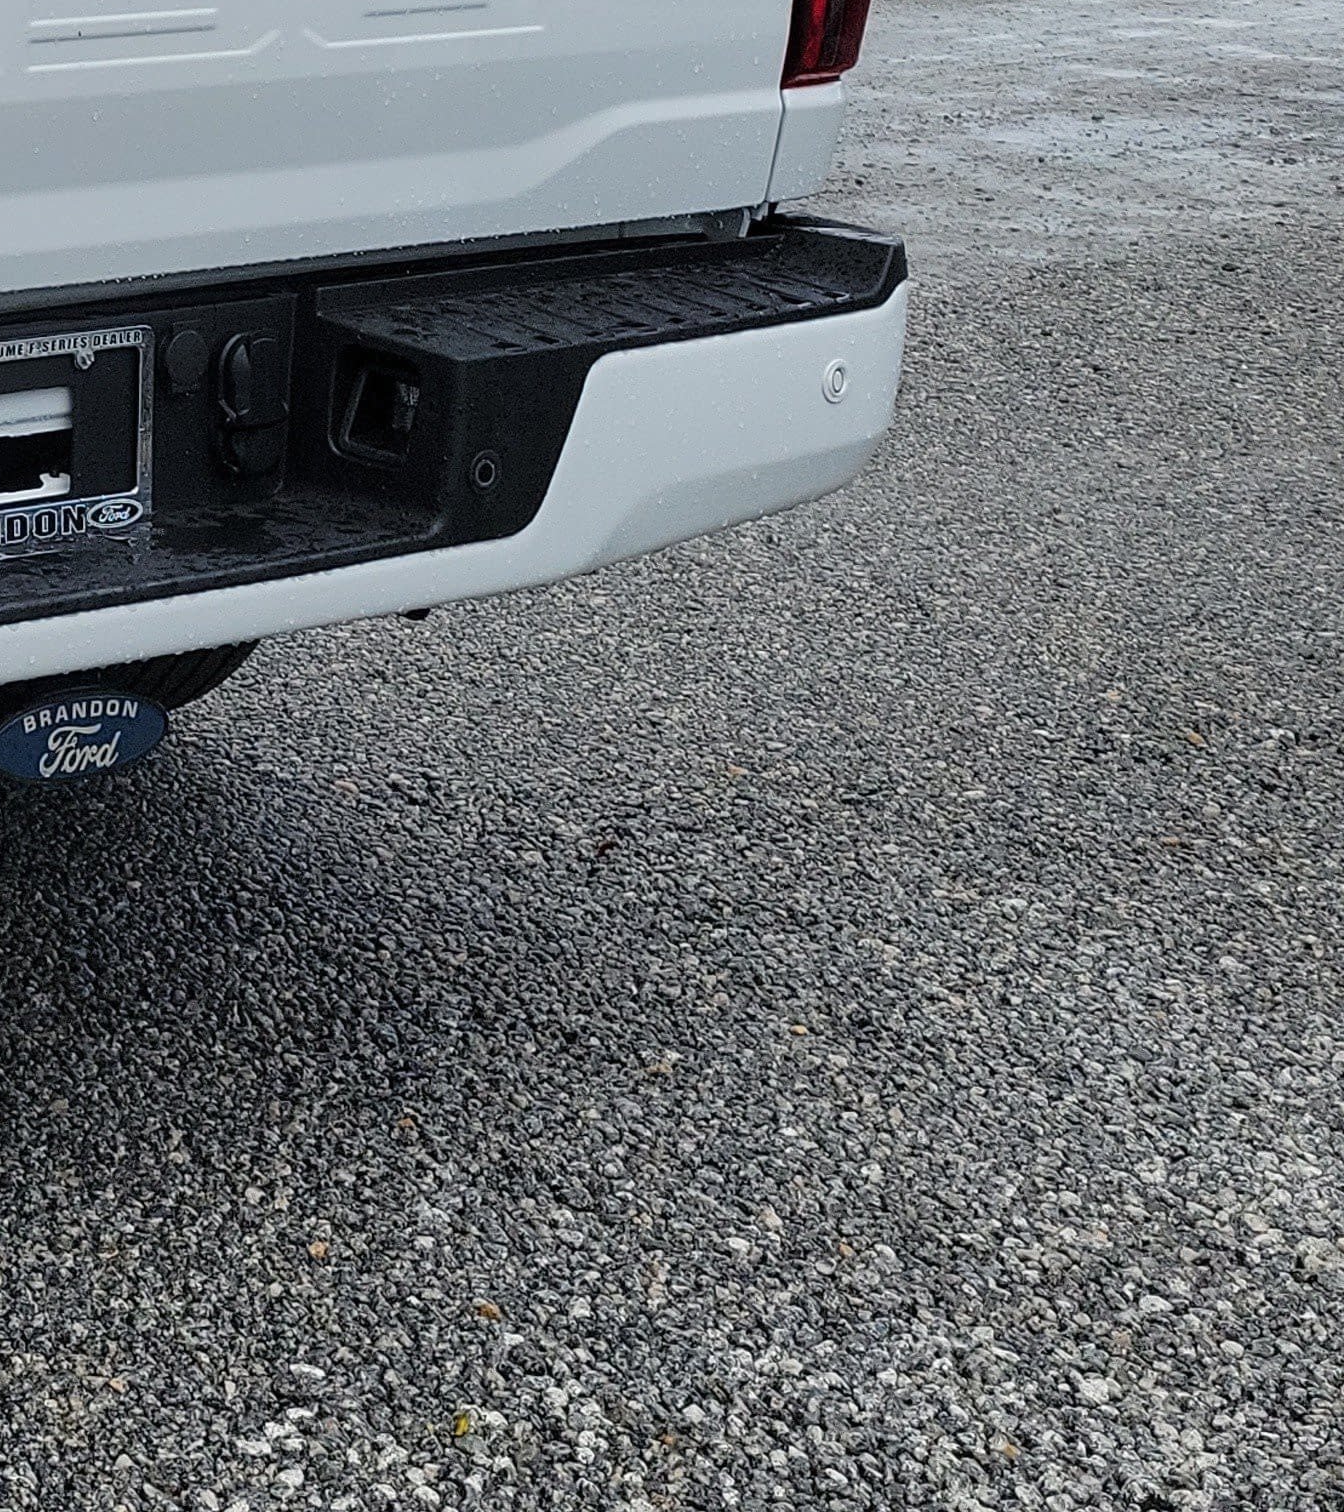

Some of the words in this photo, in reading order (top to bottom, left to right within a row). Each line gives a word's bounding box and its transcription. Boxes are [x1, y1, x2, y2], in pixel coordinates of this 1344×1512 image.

[28, 335, 89, 355] F-SERIES
[92, 330, 142, 348] DEALER
[98, 504, 132, 523] Ford
[23, 699, 138, 734] BRANDON
[38, 722, 121, 779] Ford
